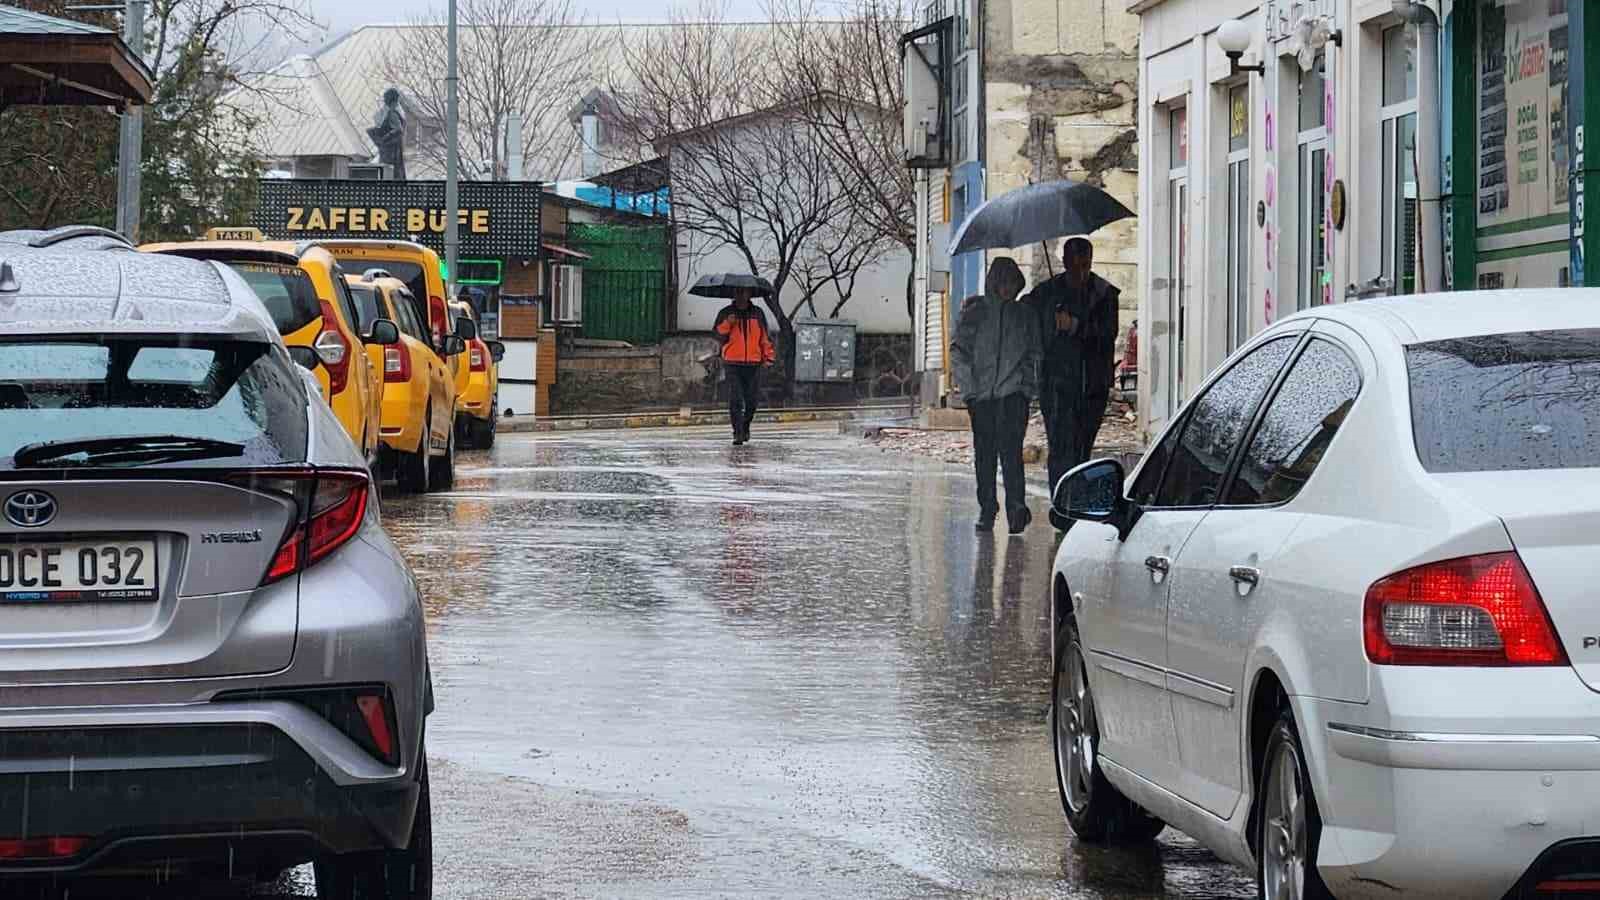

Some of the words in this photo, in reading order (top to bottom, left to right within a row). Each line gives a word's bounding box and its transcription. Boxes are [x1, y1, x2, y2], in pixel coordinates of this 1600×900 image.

[287, 207, 390, 231] ZAFER
[78, 547, 144, 586] 032
[1583, 636, 1600, 649] P
